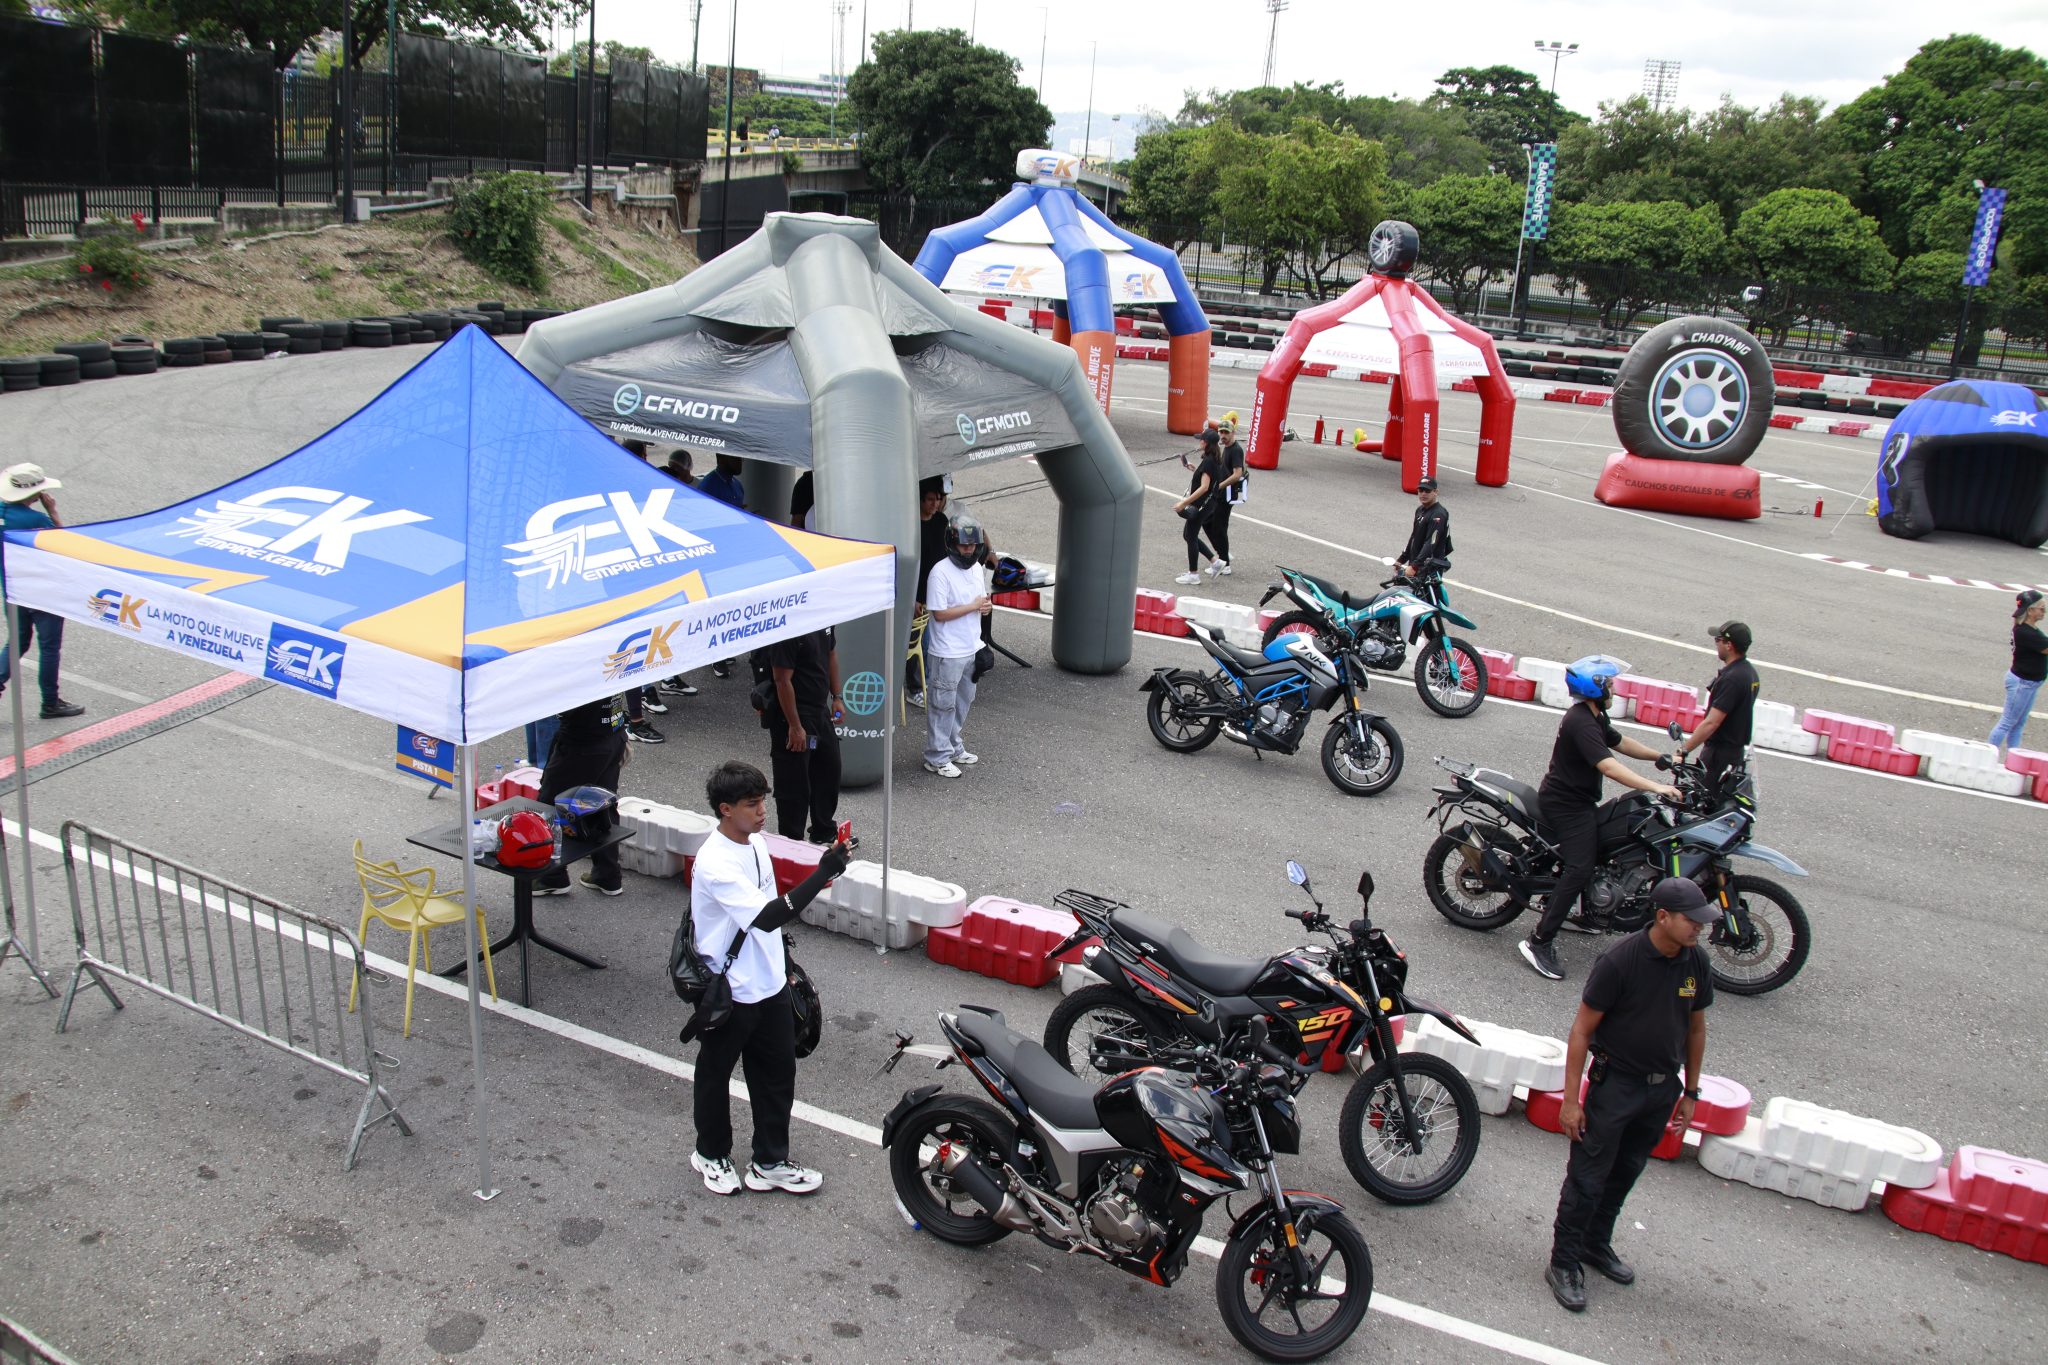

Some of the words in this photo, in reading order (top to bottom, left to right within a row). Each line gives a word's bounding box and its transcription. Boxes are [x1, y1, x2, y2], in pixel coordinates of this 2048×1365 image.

[969, 264, 1045, 290] EK
[1691, 332, 1752, 356] CHAOYANG
[1088, 345, 1101, 376] MUEVE
[644, 395, 740, 423] CFMOTO
[976, 411, 1032, 434] CFMOTO
[1249, 406, 1262, 453] OFICIALES
[1258, 390, 1265, 405] DE
[1996, 410, 2038, 427] EK
[610, 421, 620, 430] TU
[620, 423, 652, 436] PRÓXIMA
[653, 428, 690, 443] AVENTURA
[690, 434, 699, 444] TE
[699, 435, 726, 448] ESPERA
[1423, 412, 1431, 445] AGARRE
[1625, 479, 1668, 491] CAUCHOS
[1669, 484, 1713, 496] OFICIALES
[1715, 488, 1727, 496] DE
[165, 486, 434, 569] EK
[502, 488, 712, 590] EK
[193, 537, 267, 561] EMPIRE
[259, 551, 341, 576] KEEWAY
[582, 556, 656, 581] EMPIRE
[656, 544, 717, 565] KEEWAY
[87, 588, 148, 628] EK
[688, 619, 703, 635] LA
[705, 608, 741, 630] MOTO
[743, 601, 768, 620] QUE
[770, 591, 809, 612] MUEVE
[147, 606, 161, 620] LA
[162, 611, 196, 630] MOTO
[197, 620, 221, 638] QUE
[223, 628, 265, 651] MUEVE
[708, 634, 718, 648] A
[721, 614, 787, 644] VENEZUELA
[166, 630, 175, 641] A
[178, 632, 244, 662] VENEZUELA
[603, 619, 684, 682] EK
[267, 639, 344, 686] EK
[618, 666, 647, 679] EMPIRE
[412, 759, 433, 775] PISTA
[434, 767, 438, 776] 1
[425, 747, 436, 756] DAY
[1297, 1009, 1354, 1032] 150
